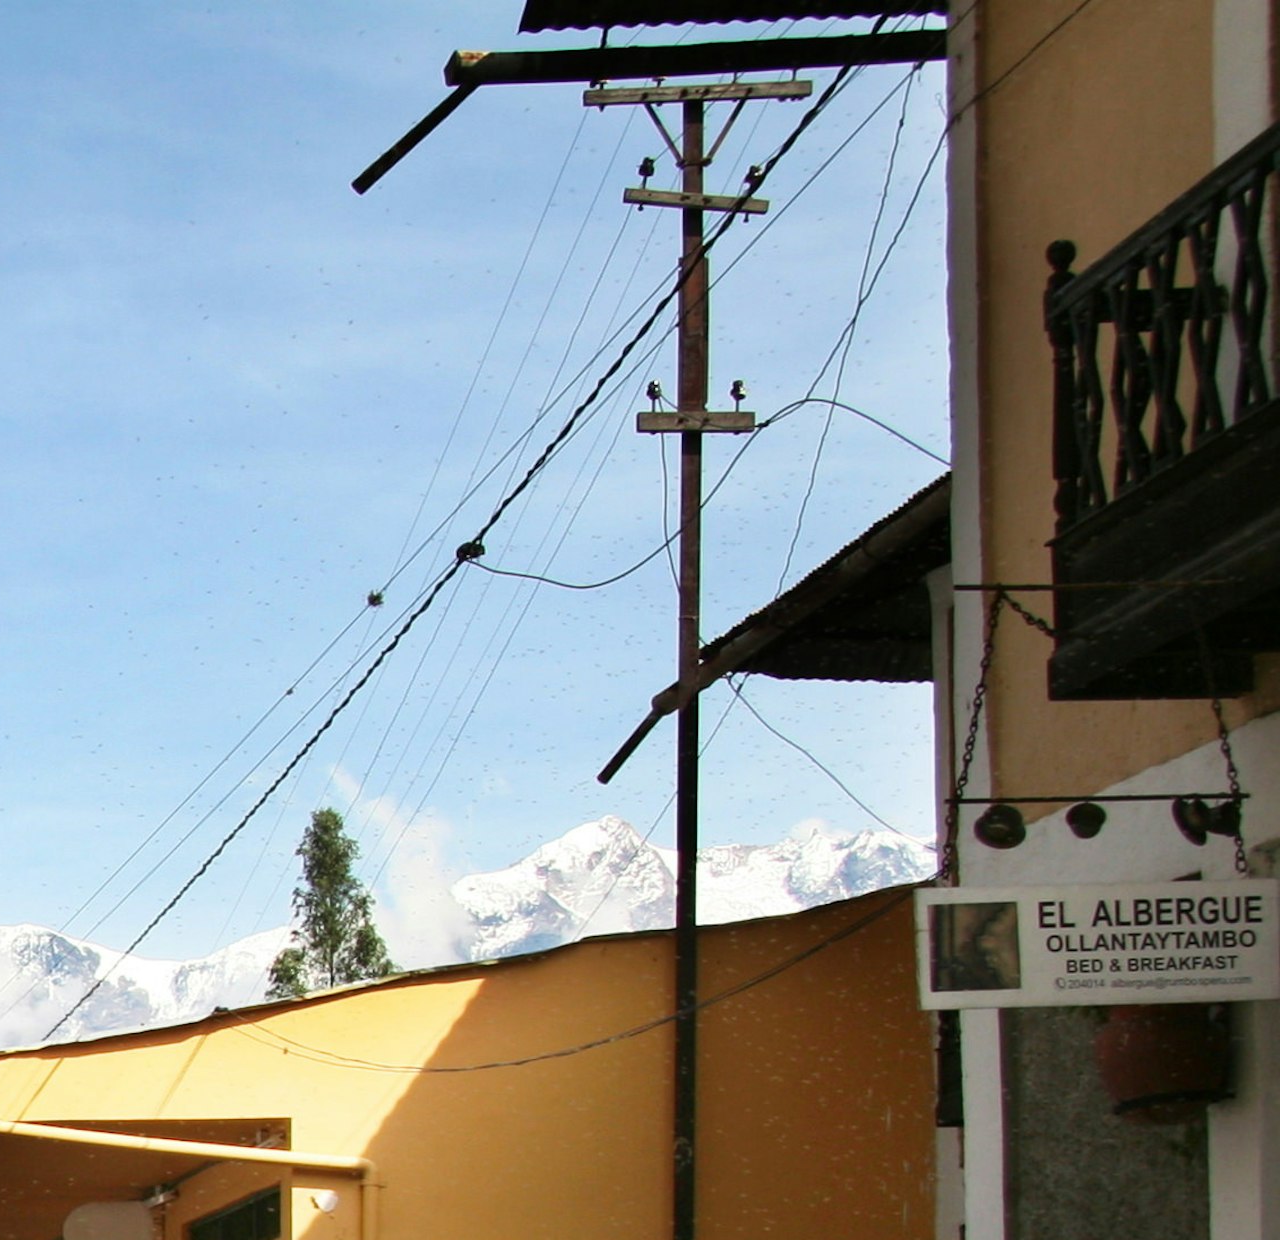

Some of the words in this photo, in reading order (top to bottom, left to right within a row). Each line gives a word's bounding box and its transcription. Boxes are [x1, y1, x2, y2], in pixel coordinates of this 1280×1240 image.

[1038, 901, 1076, 929] EL
[1092, 896, 1263, 927] ALBERGUE
[1046, 930, 1257, 952] OLLANTAYTAMBO
[1066, 959, 1104, 974] BED
[1109, 958, 1121, 972] &
[1127, 955, 1238, 972] BREAKFAST
